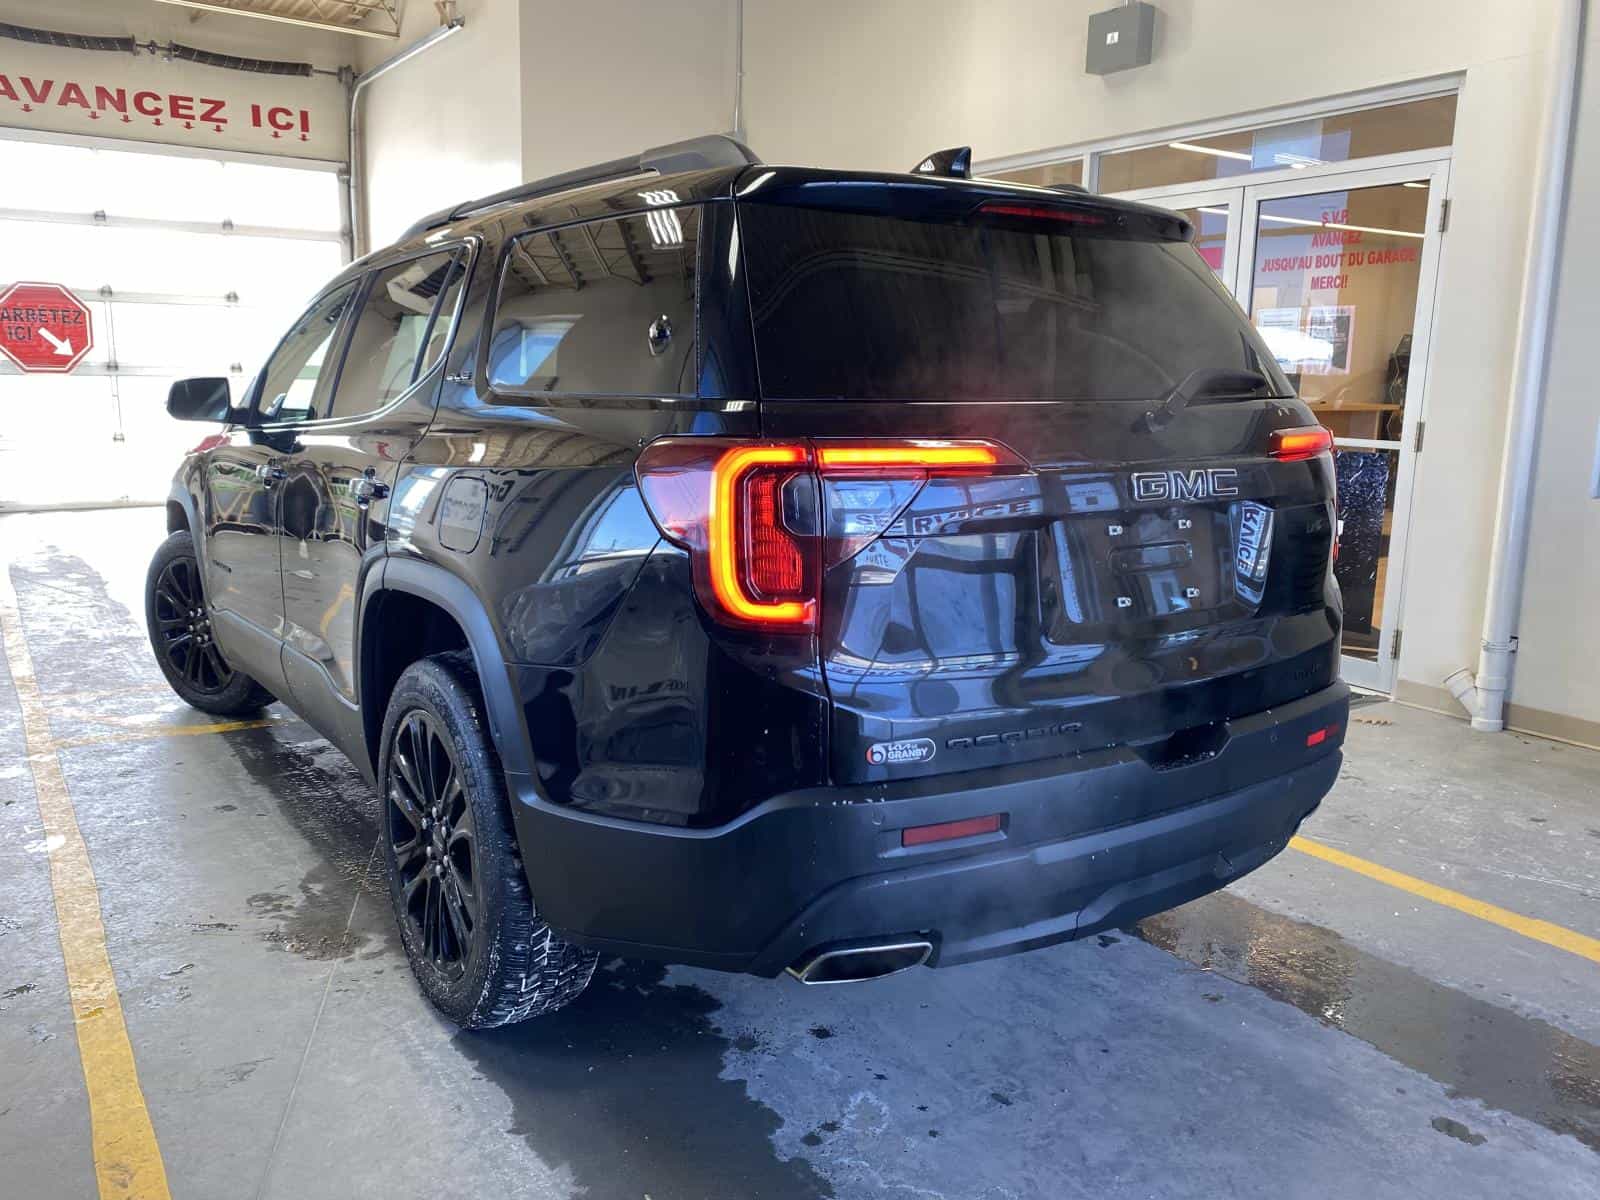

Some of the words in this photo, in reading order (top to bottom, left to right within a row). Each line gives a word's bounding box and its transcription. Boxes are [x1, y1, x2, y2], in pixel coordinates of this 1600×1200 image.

[0, 74, 228, 124] AVANCEZ
[251, 104, 311, 133] ICI
[1311, 230, 1362, 248] AVANCEZ
[1261, 256, 1312, 272] JUSQU'AU
[1315, 254, 1345, 268] BOUT
[1348, 252, 1364, 267] DU
[1367, 248, 1418, 265] GARAGE
[8, 326, 32, 341] ICI
[1131, 468, 1239, 501] GMC
[887, 747, 928, 760] GRANBY
